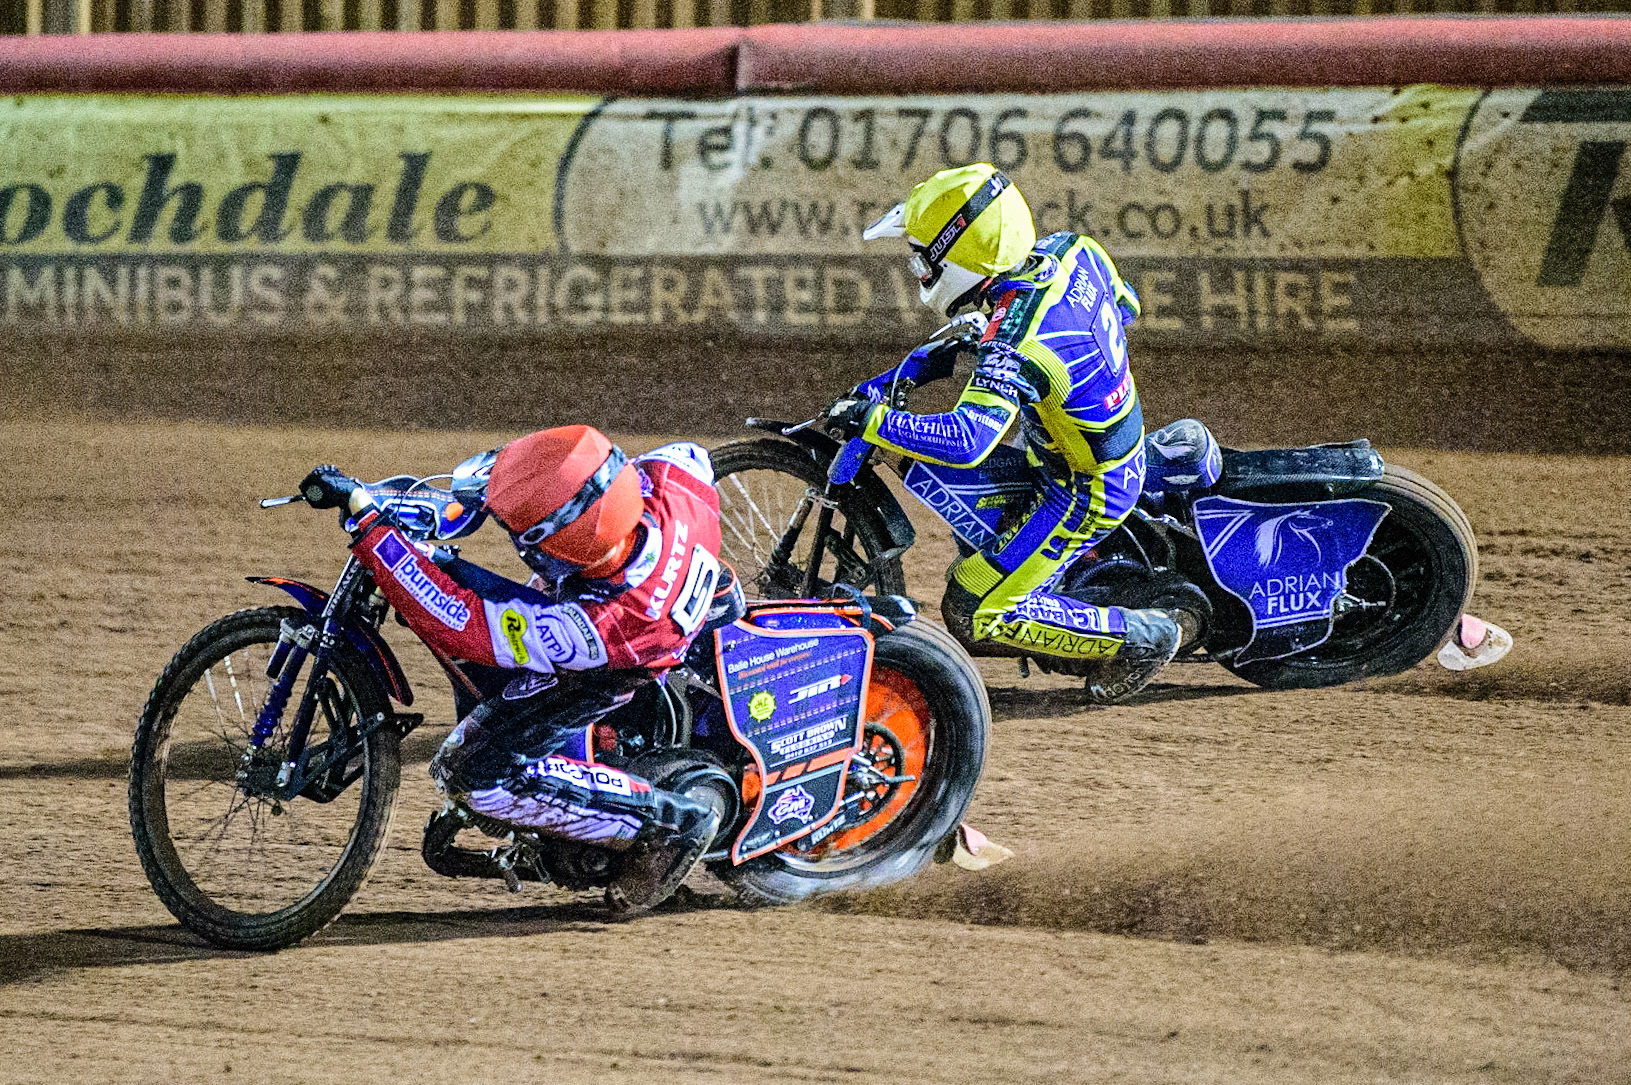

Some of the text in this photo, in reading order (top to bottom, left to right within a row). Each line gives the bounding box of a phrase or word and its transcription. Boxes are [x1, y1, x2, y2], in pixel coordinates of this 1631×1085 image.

[799, 106, 1029, 173] 01706
[1052, 107, 1338, 174] 640055
[6, 263, 286, 327] MINIBUS
[306, 263, 348, 326] &
[369, 263, 872, 326] REFRIGERATED
[1201, 271, 1360, 332] HIRE
[1065, 265, 1089, 309] ADRIAN
[1080, 280, 1099, 313] FLUX
[1100, 300, 1125, 371] 2
[975, 376, 1018, 398] LYNCH
[911, 479, 995, 547] ADRIAN
[645, 519, 689, 621] KURTZ
[1249, 571, 1342, 600] ADRIAN
[400, 556, 469, 624] burnside
[1266, 590, 1322, 616] FLUX
[535, 625, 566, 657] ATPI
[749, 651, 775, 667] House
[775, 638, 820, 658] Warehouse
[1019, 626, 1117, 655] ADRIAN
[770, 732, 805, 754] SCOTT
[806, 717, 847, 740] BROWN
